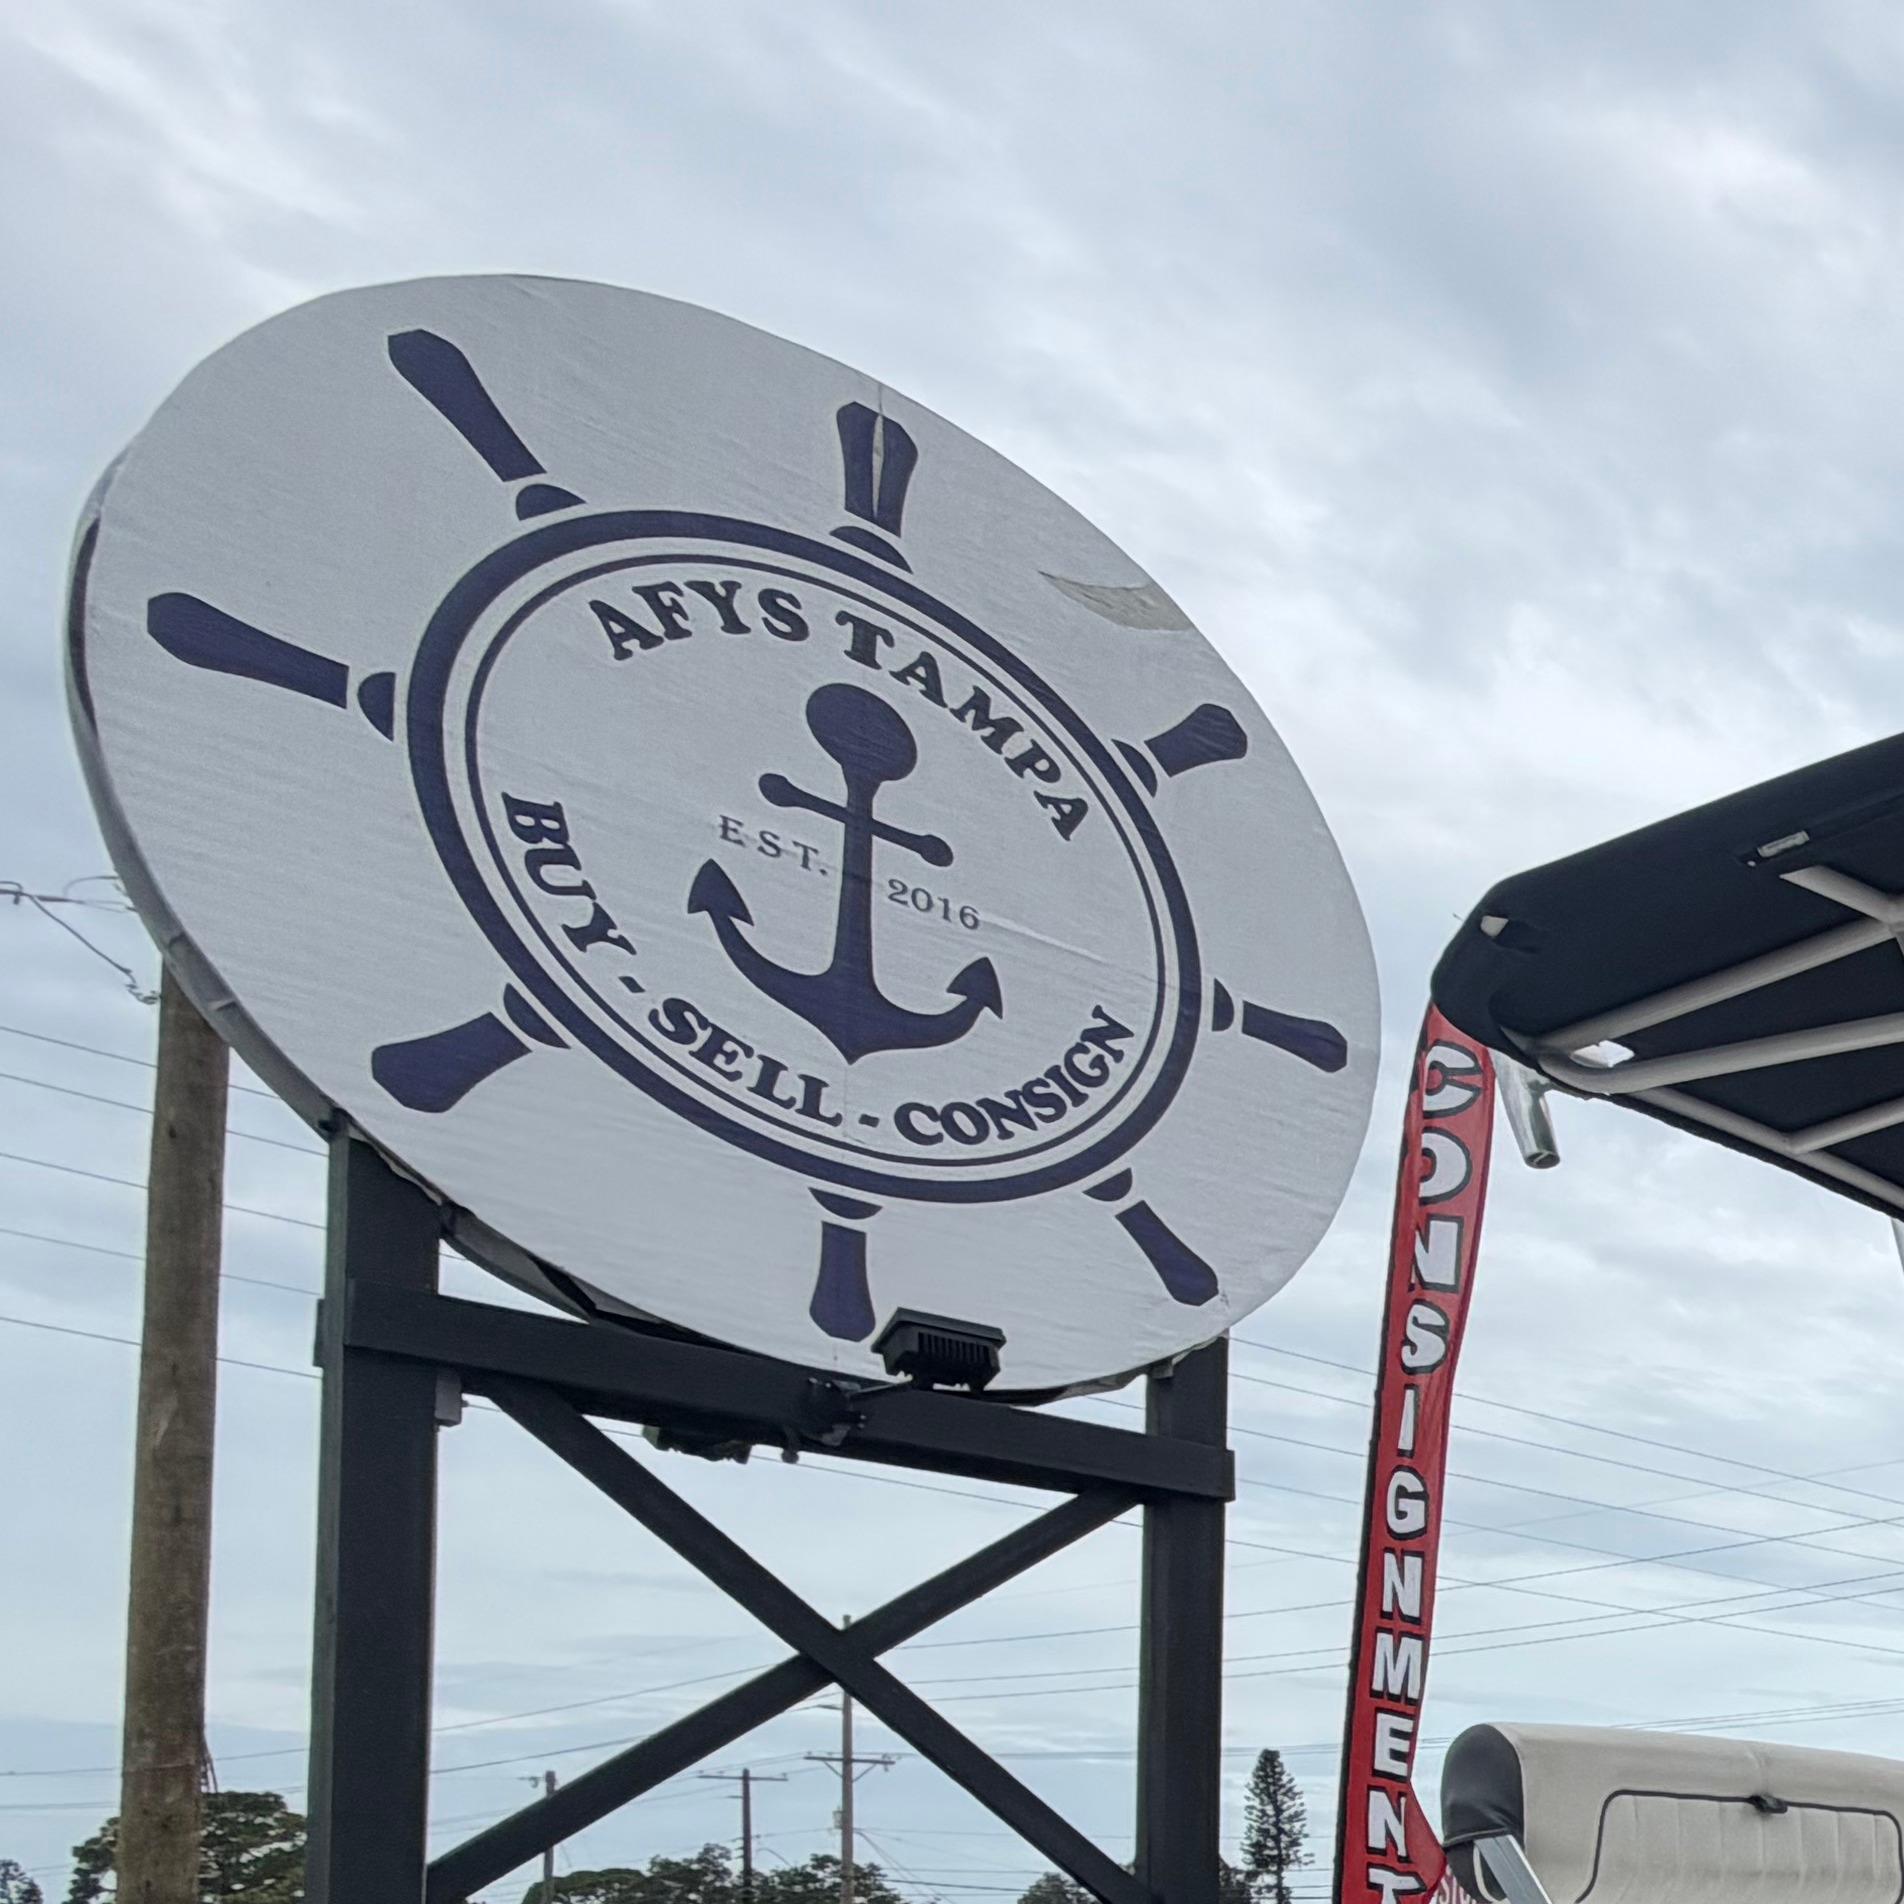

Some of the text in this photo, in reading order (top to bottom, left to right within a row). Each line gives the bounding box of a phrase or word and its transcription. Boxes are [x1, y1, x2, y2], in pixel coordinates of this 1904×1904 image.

[587, 578, 1093, 842] AFYS TAMPA
[501, 791, 638, 957] BUY
[647, 996, 843, 1129] SELL
[893, 1005, 1136, 1147] CONSIGN
[717, 813, 981, 932] EST. 2016
